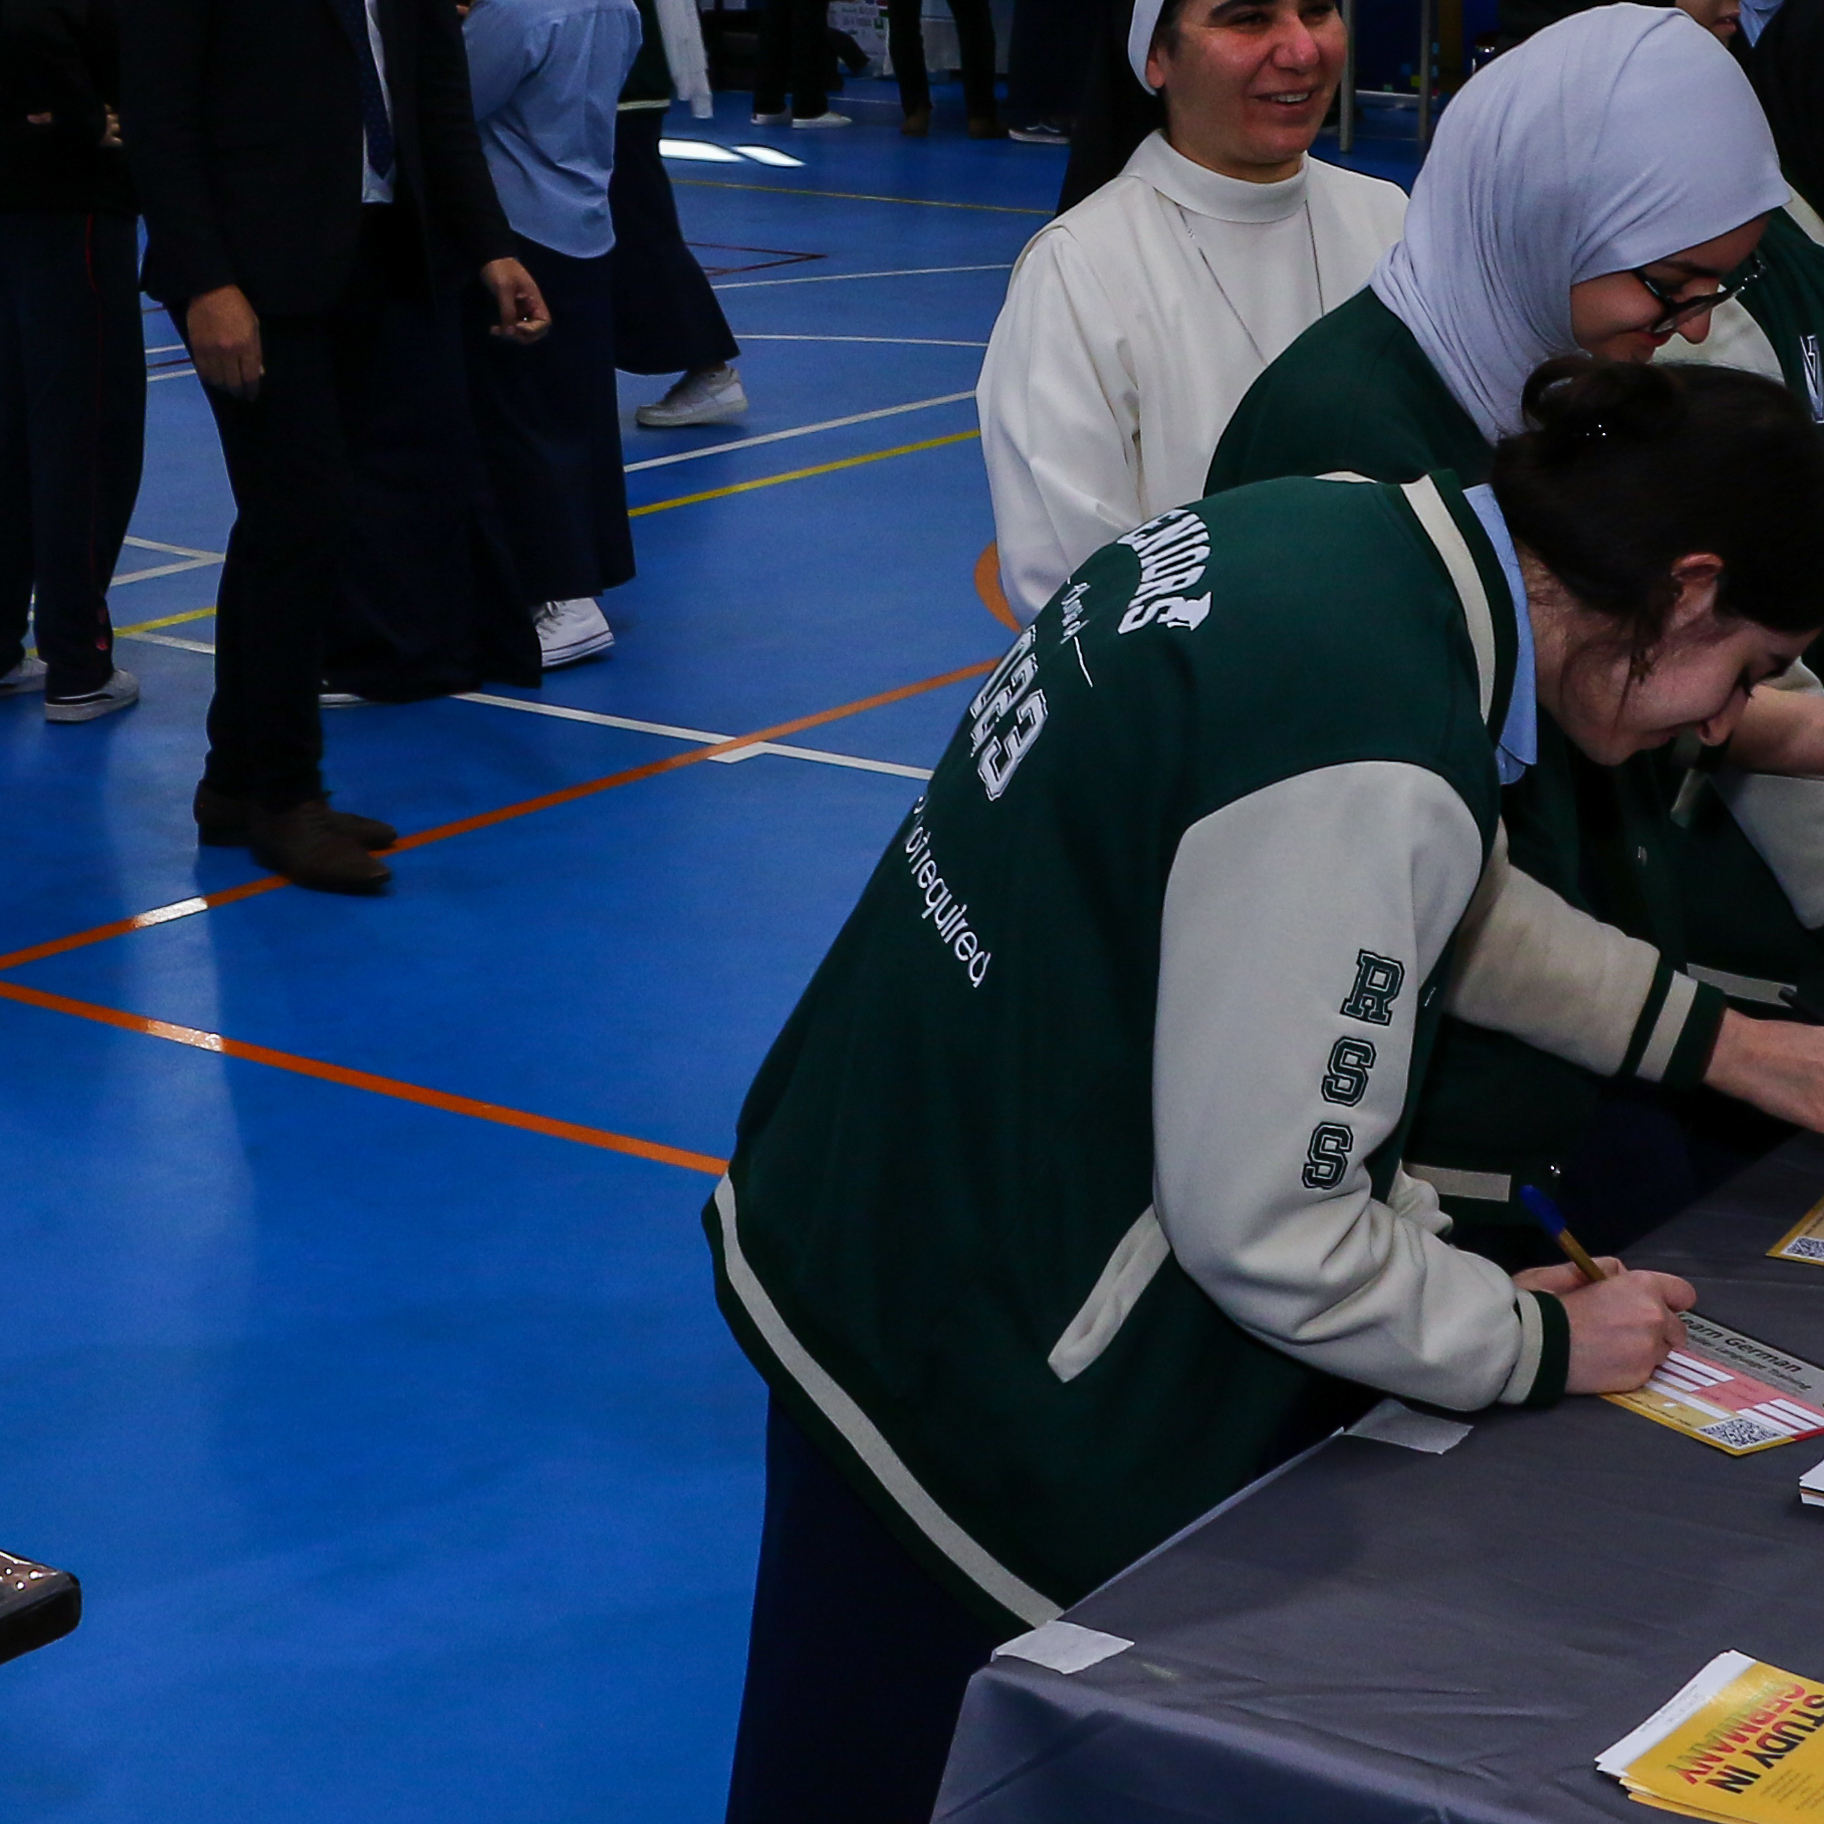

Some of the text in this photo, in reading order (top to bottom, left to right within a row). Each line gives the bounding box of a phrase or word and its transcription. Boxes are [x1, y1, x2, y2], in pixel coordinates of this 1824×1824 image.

[1117, 507, 1213, 635] ENIORS
[969, 624, 1050, 802] 023
[910, 848, 992, 989] required
[1725, 1336, 1803, 1373] German
[1668, 1679, 1806, 1786] GERMANY
[1705, 1764, 1761, 1794] IN
